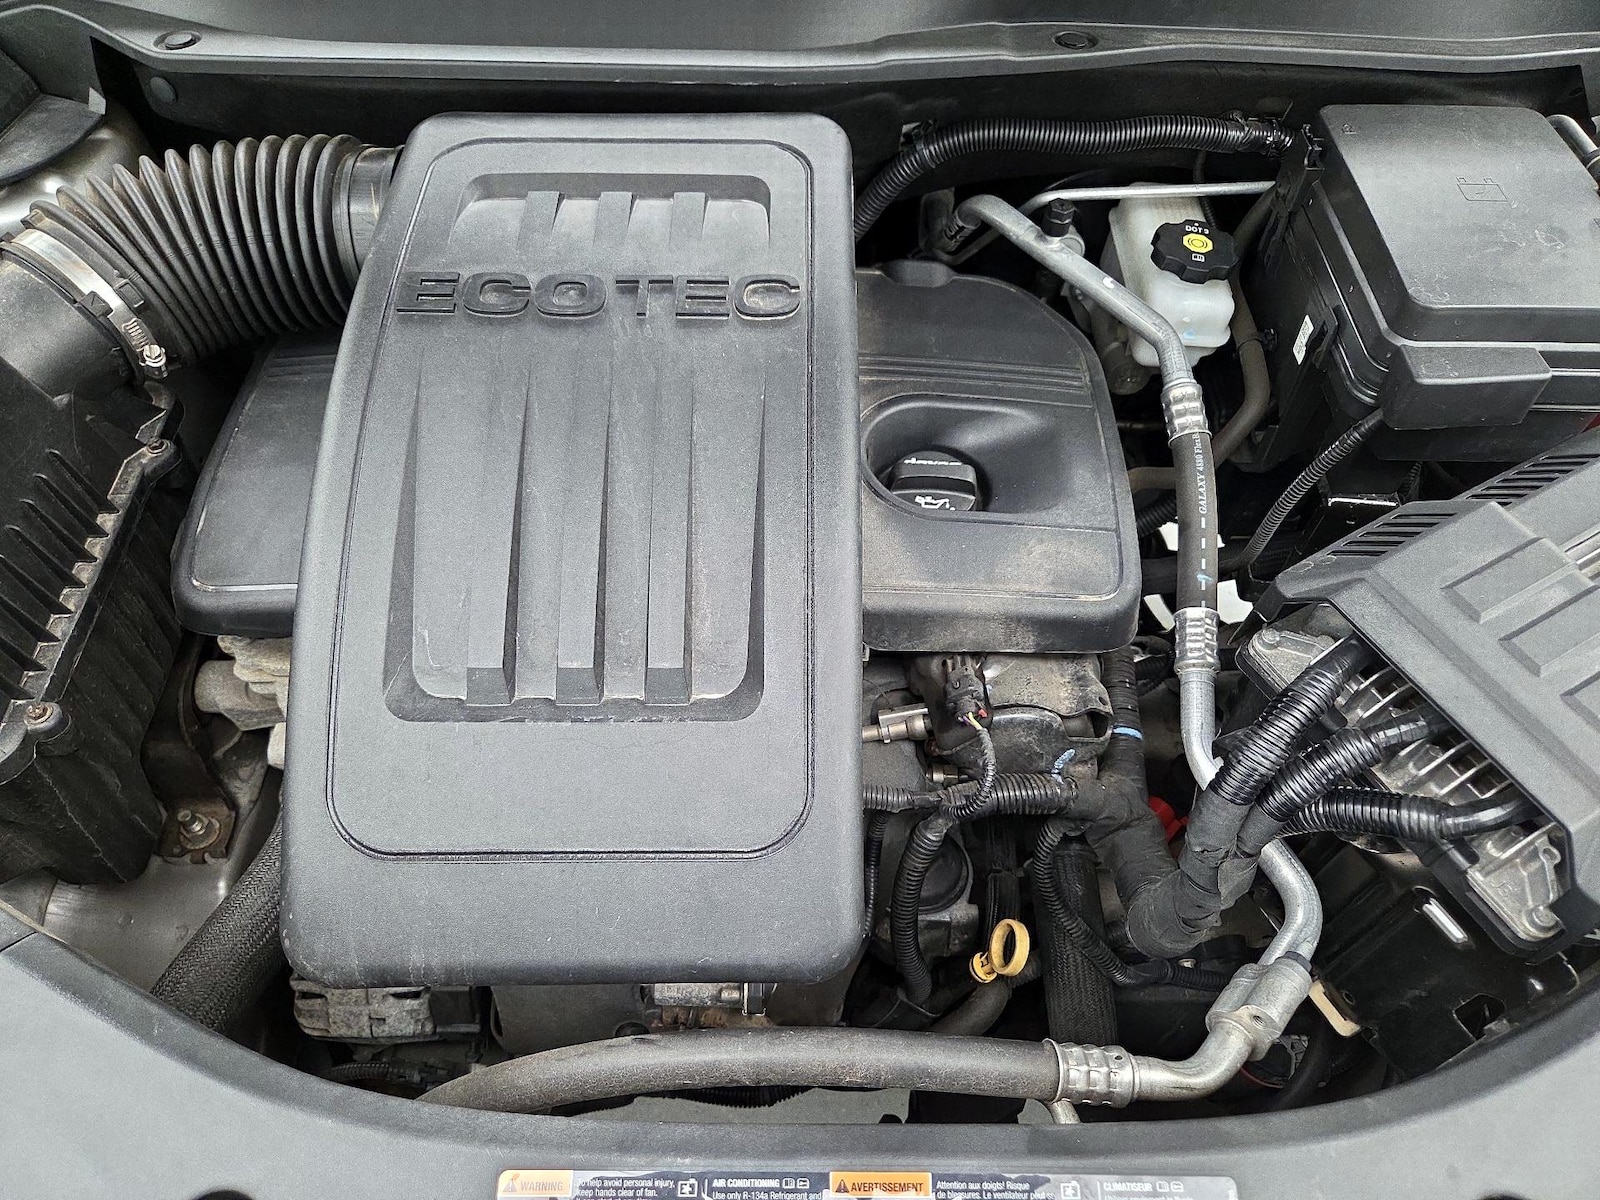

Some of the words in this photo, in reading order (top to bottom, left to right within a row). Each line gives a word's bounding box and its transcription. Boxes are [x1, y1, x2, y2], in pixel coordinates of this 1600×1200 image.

[1185, 225, 1203, 234] DOT
[396, 271, 801, 321] ECOTEC
[1195, 455, 1204, 471] 4880
[1197, 473, 1206, 514] GALAXY
[520, 1180, 563, 1192] WARNING
[577, 1178, 586, 1187] To
[586, 1178, 602, 1188] help
[603, 1178, 622, 1187] avoid
[623, 1178, 653, 1188] personal
[654, 1178, 675, 1189] injury,
[712, 1178, 726, 1188] AIR
[727, 1178, 780, 1188] CONDITIONING
[851, 1182, 923, 1193] AVERTISSEMENT
[936, 1180, 967, 1190] Attention
[968, 1182, 981, 1190] aux
[982, 1181, 1005, 1191] doigts!
[1006, 1181, 1030, 1191] Risque
[1103, 1181, 1153, 1192] CLIMATISEUR
[595, 1188, 616, 1197] hands
[617, 1188, 635, 1197] clear
[636, 1188, 644, 1197] of
[644, 1188, 658, 1197] fan.
[712, 1191, 726, 1200] Use
[727, 1191, 741, 1200] only
[742, 1191, 769, 1200] R-134a
[770, 1191, 807, 1200] Refrigerant
[808, 1191, 822, 1200] and
[936, 1190, 946, 1199] de
[983, 1190, 992, 1199] Le
